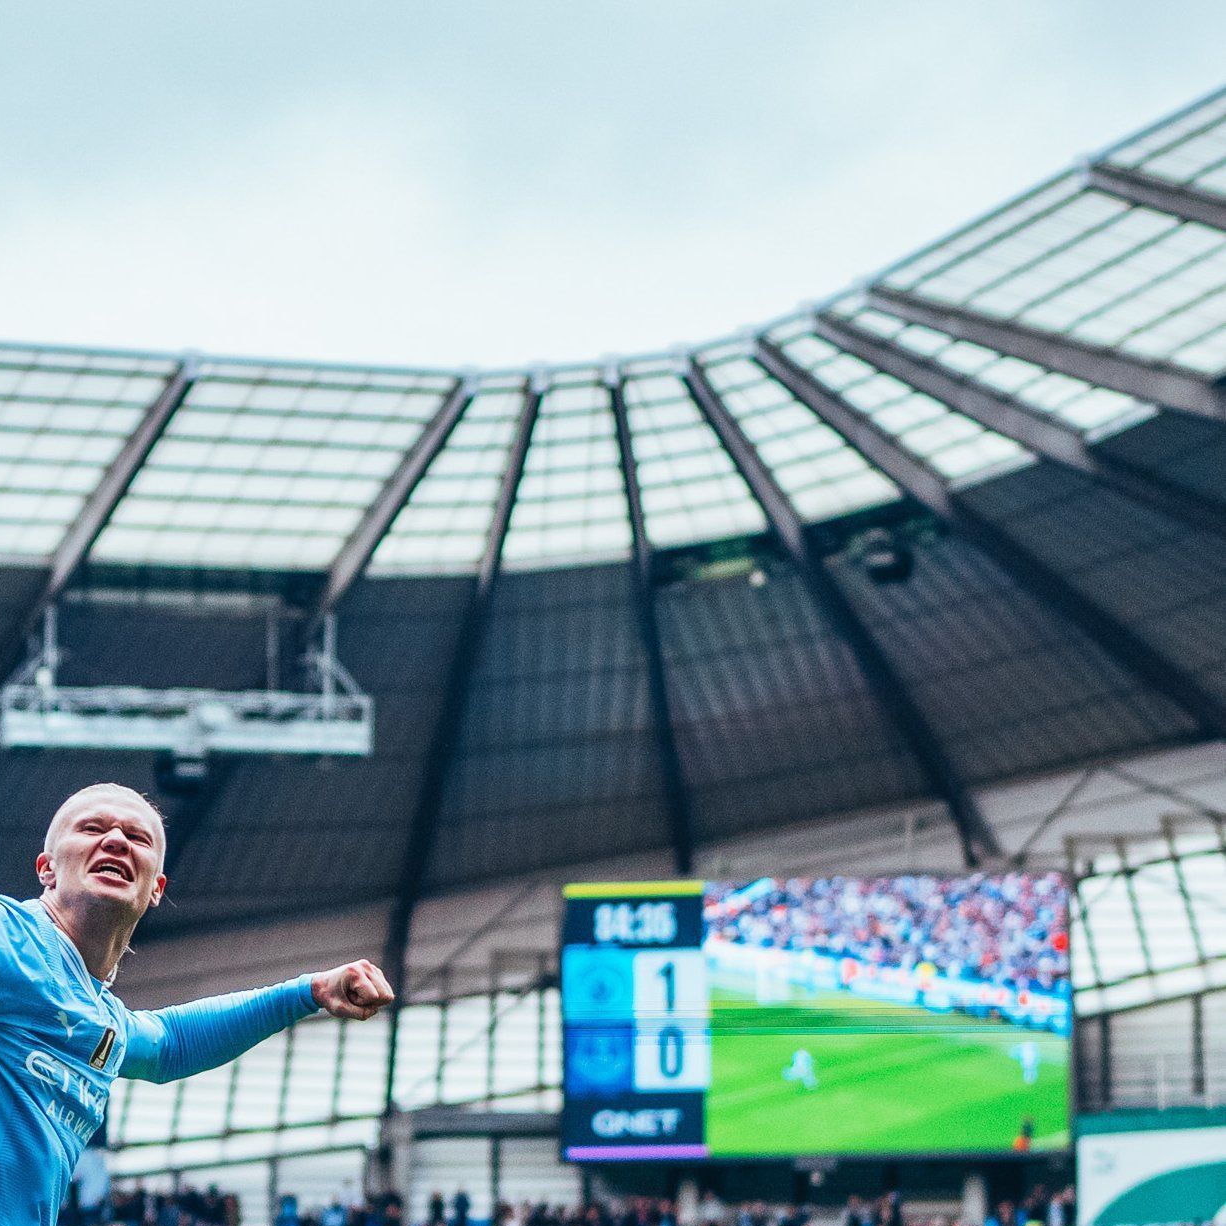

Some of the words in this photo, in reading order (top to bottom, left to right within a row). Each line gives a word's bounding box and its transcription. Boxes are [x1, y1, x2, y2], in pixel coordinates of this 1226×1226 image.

[658, 961, 675, 1013] 1
[659, 1027, 683, 1078] 0
[25, 1050, 108, 1116] ETIHA
